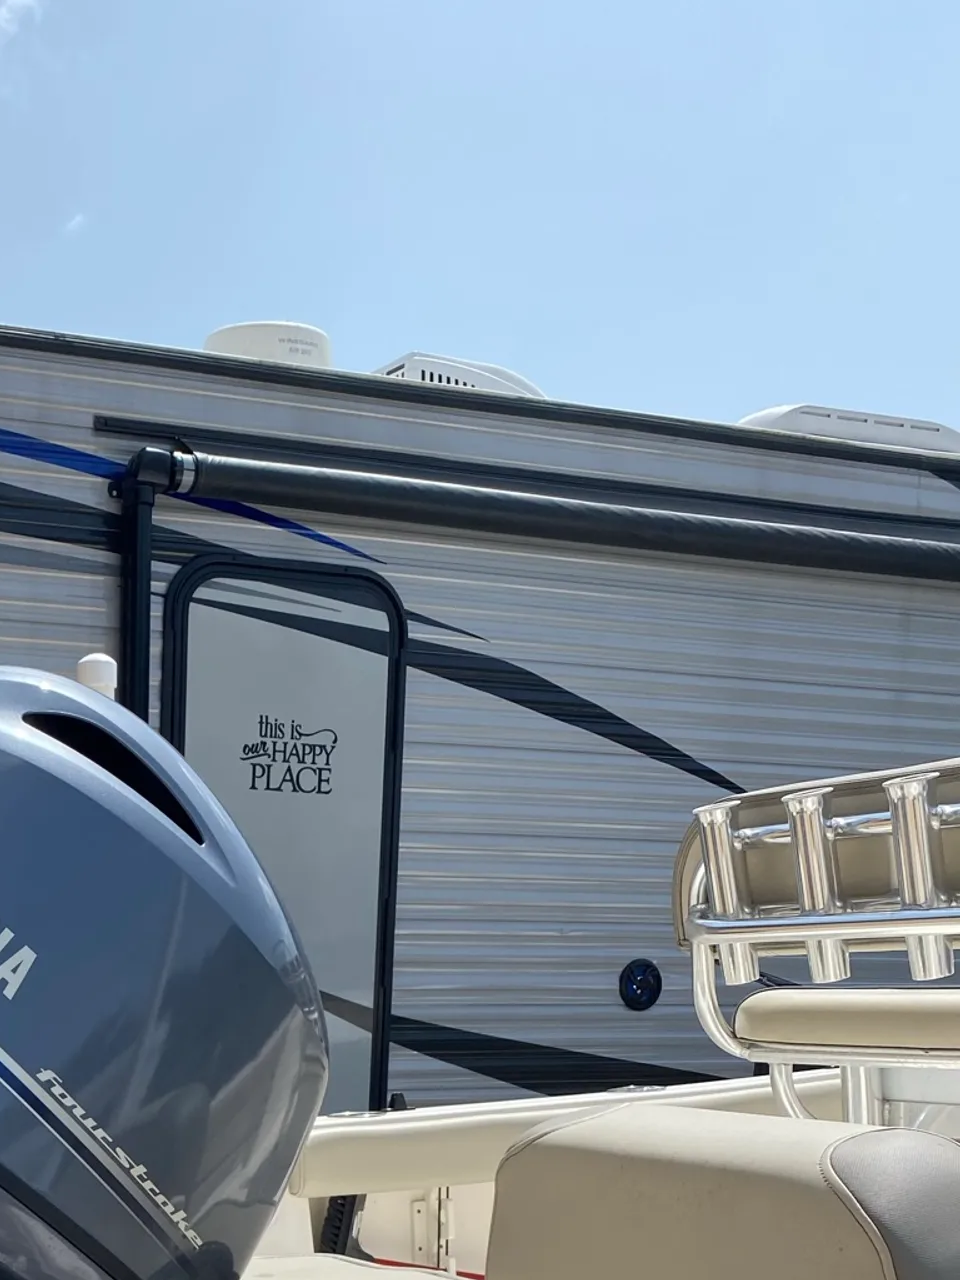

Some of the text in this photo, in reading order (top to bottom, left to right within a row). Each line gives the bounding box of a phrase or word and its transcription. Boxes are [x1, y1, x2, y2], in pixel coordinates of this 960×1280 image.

[258, 714, 285, 739] this
[242, 740, 336, 766] our HAPPY
[248, 762, 333, 795] PLACE
